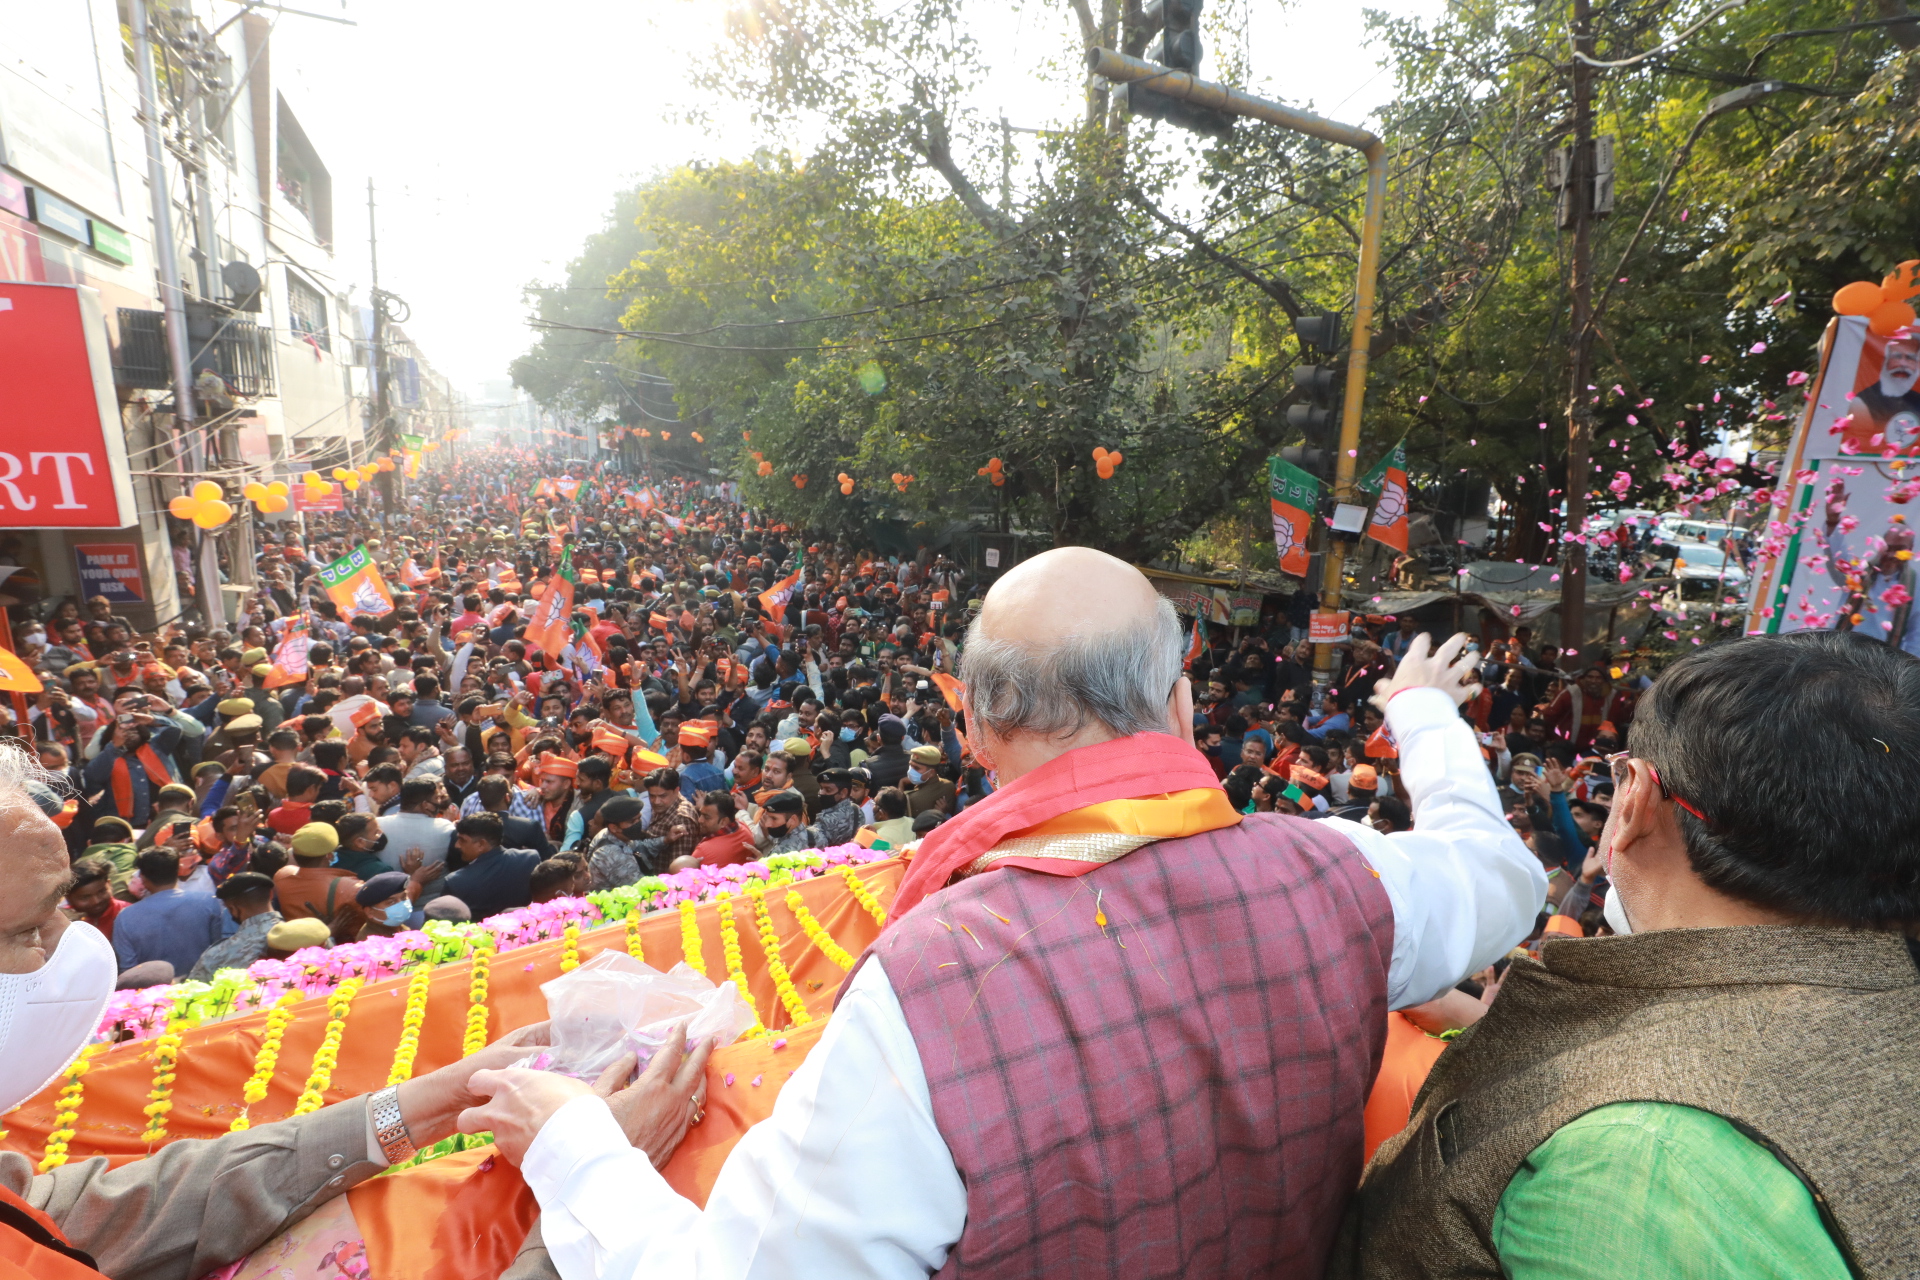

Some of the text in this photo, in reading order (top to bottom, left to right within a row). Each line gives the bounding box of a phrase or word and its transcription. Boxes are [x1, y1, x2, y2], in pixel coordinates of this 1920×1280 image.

[86, 555, 129, 565] PARK AT
[319, 549, 365, 582] BJP
[81, 568, 138, 579] YOUR OWN
[99, 582, 127, 592] RISK
